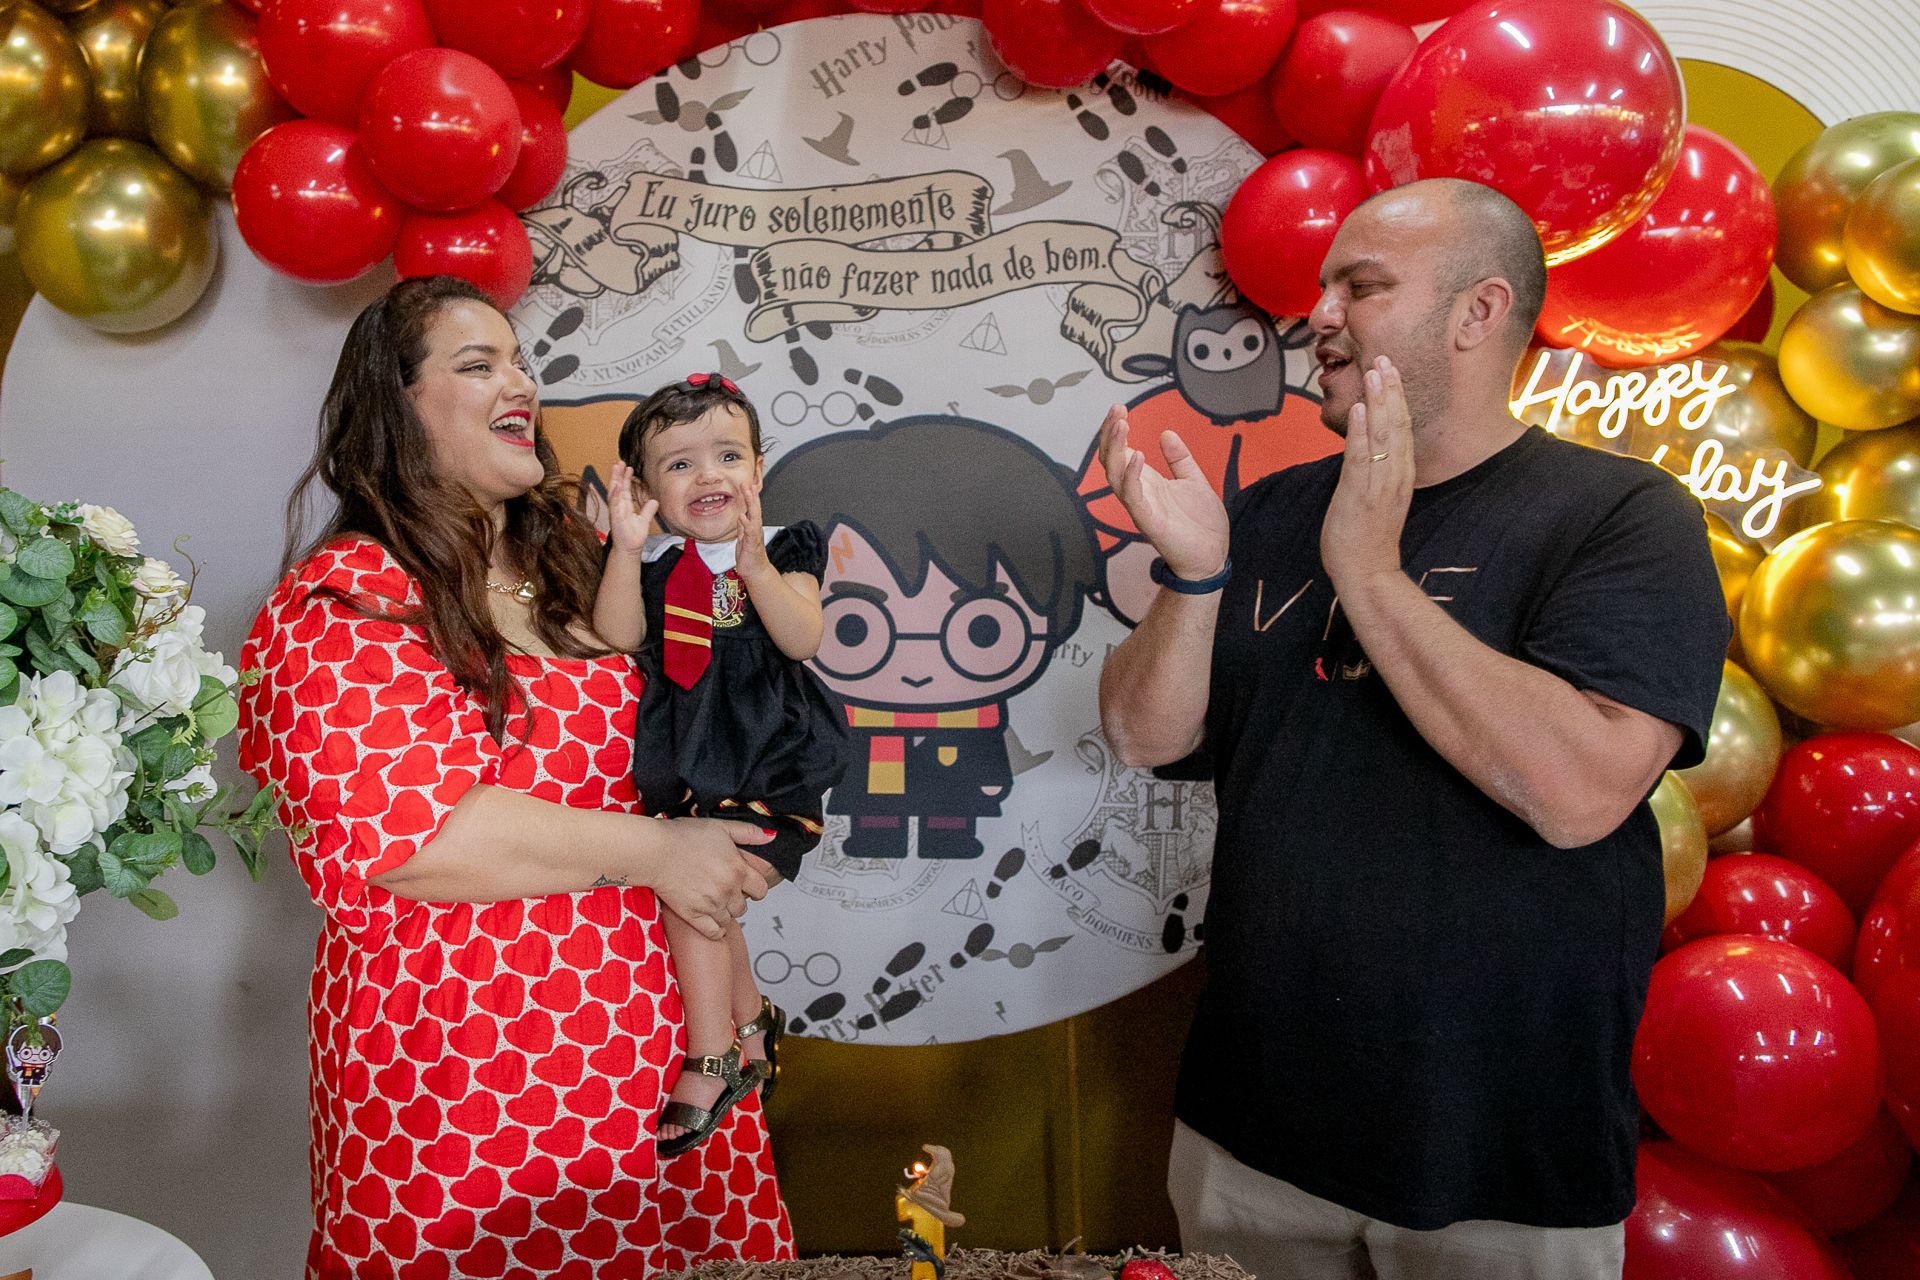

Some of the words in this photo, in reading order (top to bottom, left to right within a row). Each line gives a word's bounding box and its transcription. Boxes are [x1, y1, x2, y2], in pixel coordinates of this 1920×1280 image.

[809, 36, 887, 100] Harry
[638, 179, 678, 220] Eu
[684, 193, 756, 233] juro
[767, 183, 956, 234] solenemente
[839, 262, 920, 299] fazer
[931, 253, 994, 294] nada
[1003, 244, 1036, 281] de
[1042, 239, 1107, 275] bom.
[1509, 351, 1736, 438] Happy
